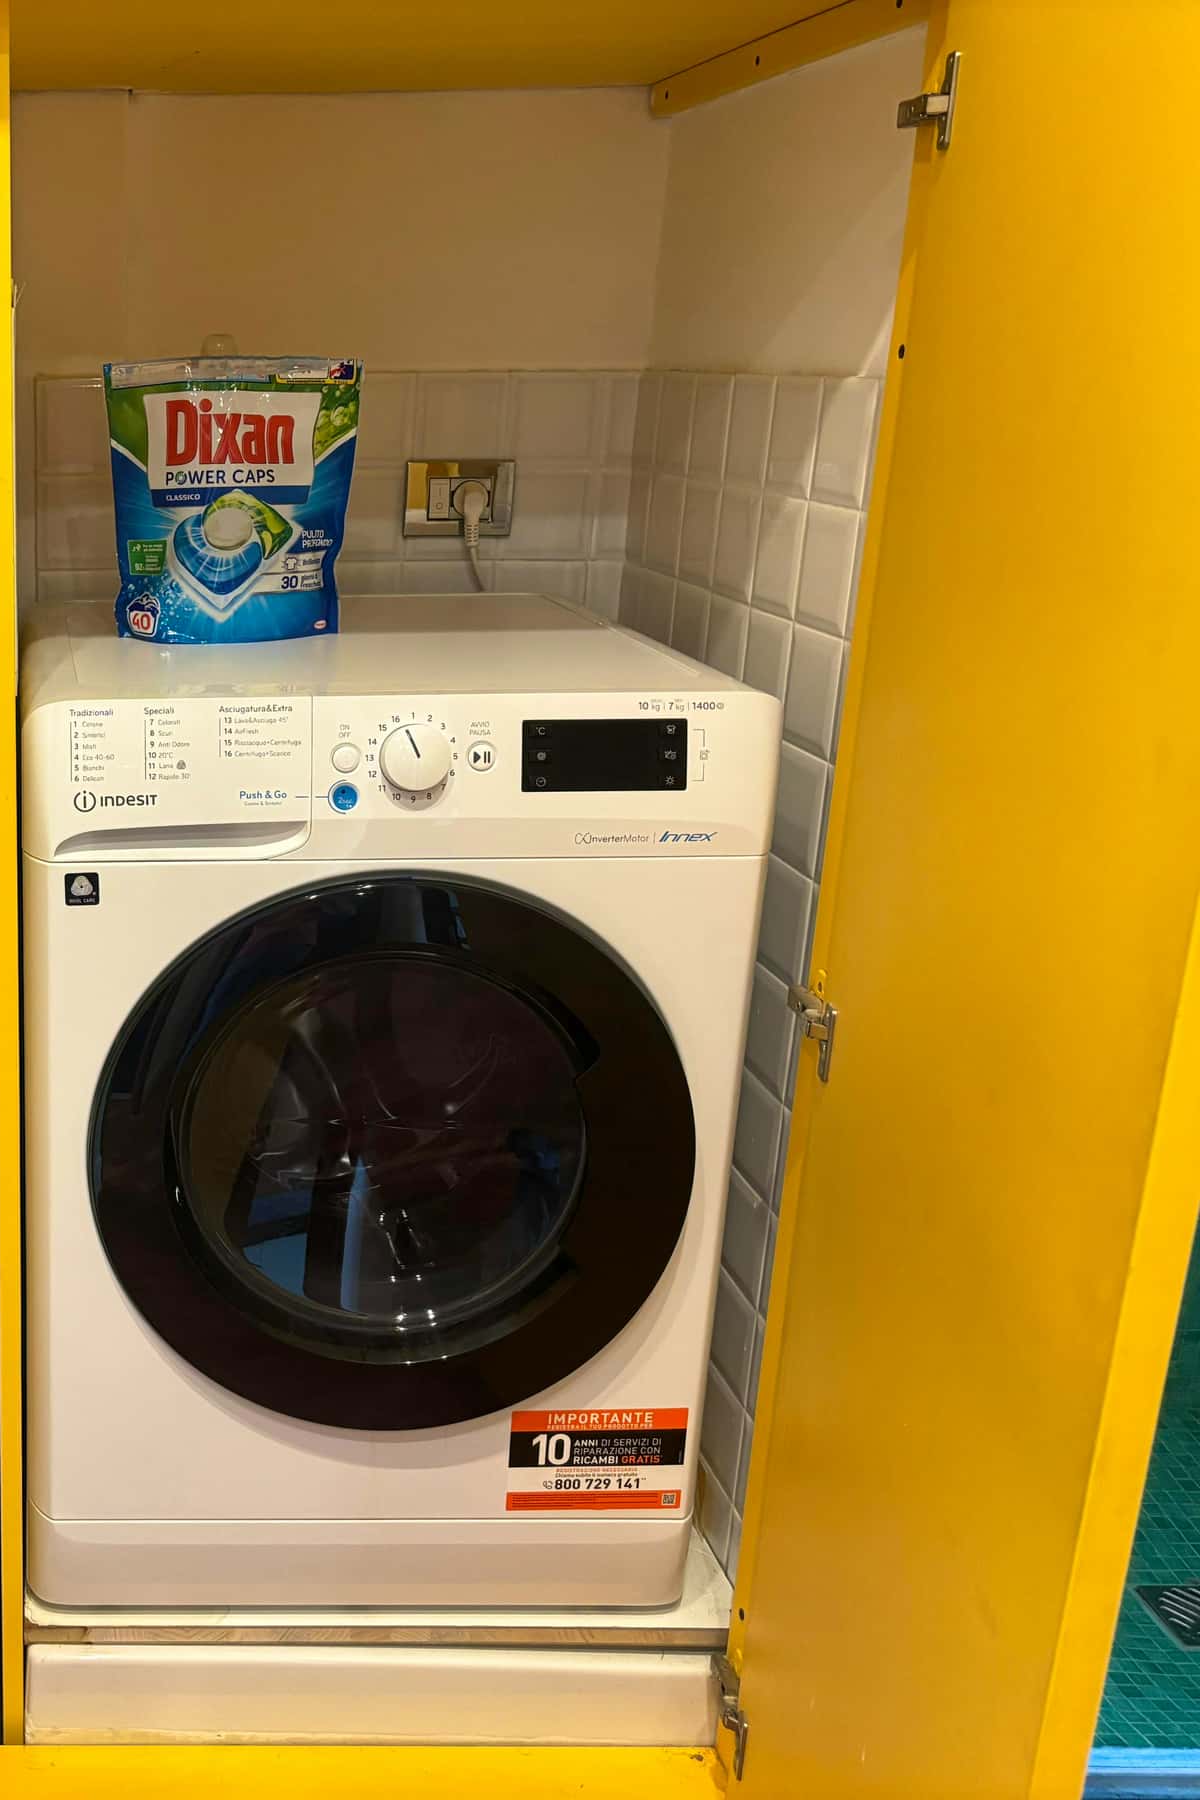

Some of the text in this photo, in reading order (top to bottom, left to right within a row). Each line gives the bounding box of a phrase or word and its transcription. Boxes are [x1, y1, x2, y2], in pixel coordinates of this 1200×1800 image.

[166, 398, 295, 466] Dixan
[165, 469, 275, 486] POWER CAPS
[166, 493, 200, 502] CLASSICO
[281, 575, 298, 589] 30
[132, 612, 151, 630] 40
[219, 704, 293, 714] Asciugatura&Extra
[639, 702, 649, 710] 10
[668, 702, 674, 710] 7
[692, 702, 716, 710] 1400
[69, 708, 114, 717] Tradizionali
[143, 707, 175, 716] Speciali
[368, 770, 377, 778] 12
[450, 769, 455, 777] 6
[240, 790, 287, 799] Push & Go
[392, 793, 400, 801] 10
[659, 831, 718, 843] Innex
[548, 1412, 654, 1425] IMPORTANTE
[574, 1437, 662, 1447] ANNI DI SERVIZI DI
[532, 1433, 571, 1466] 10
[573, 1446, 661, 1455] RIPARAZIONE CON
[573, 1455, 619, 1465] RICAMBI
[555, 1479, 580, 1490] 800
[585, 1478, 611, 1489] 729
